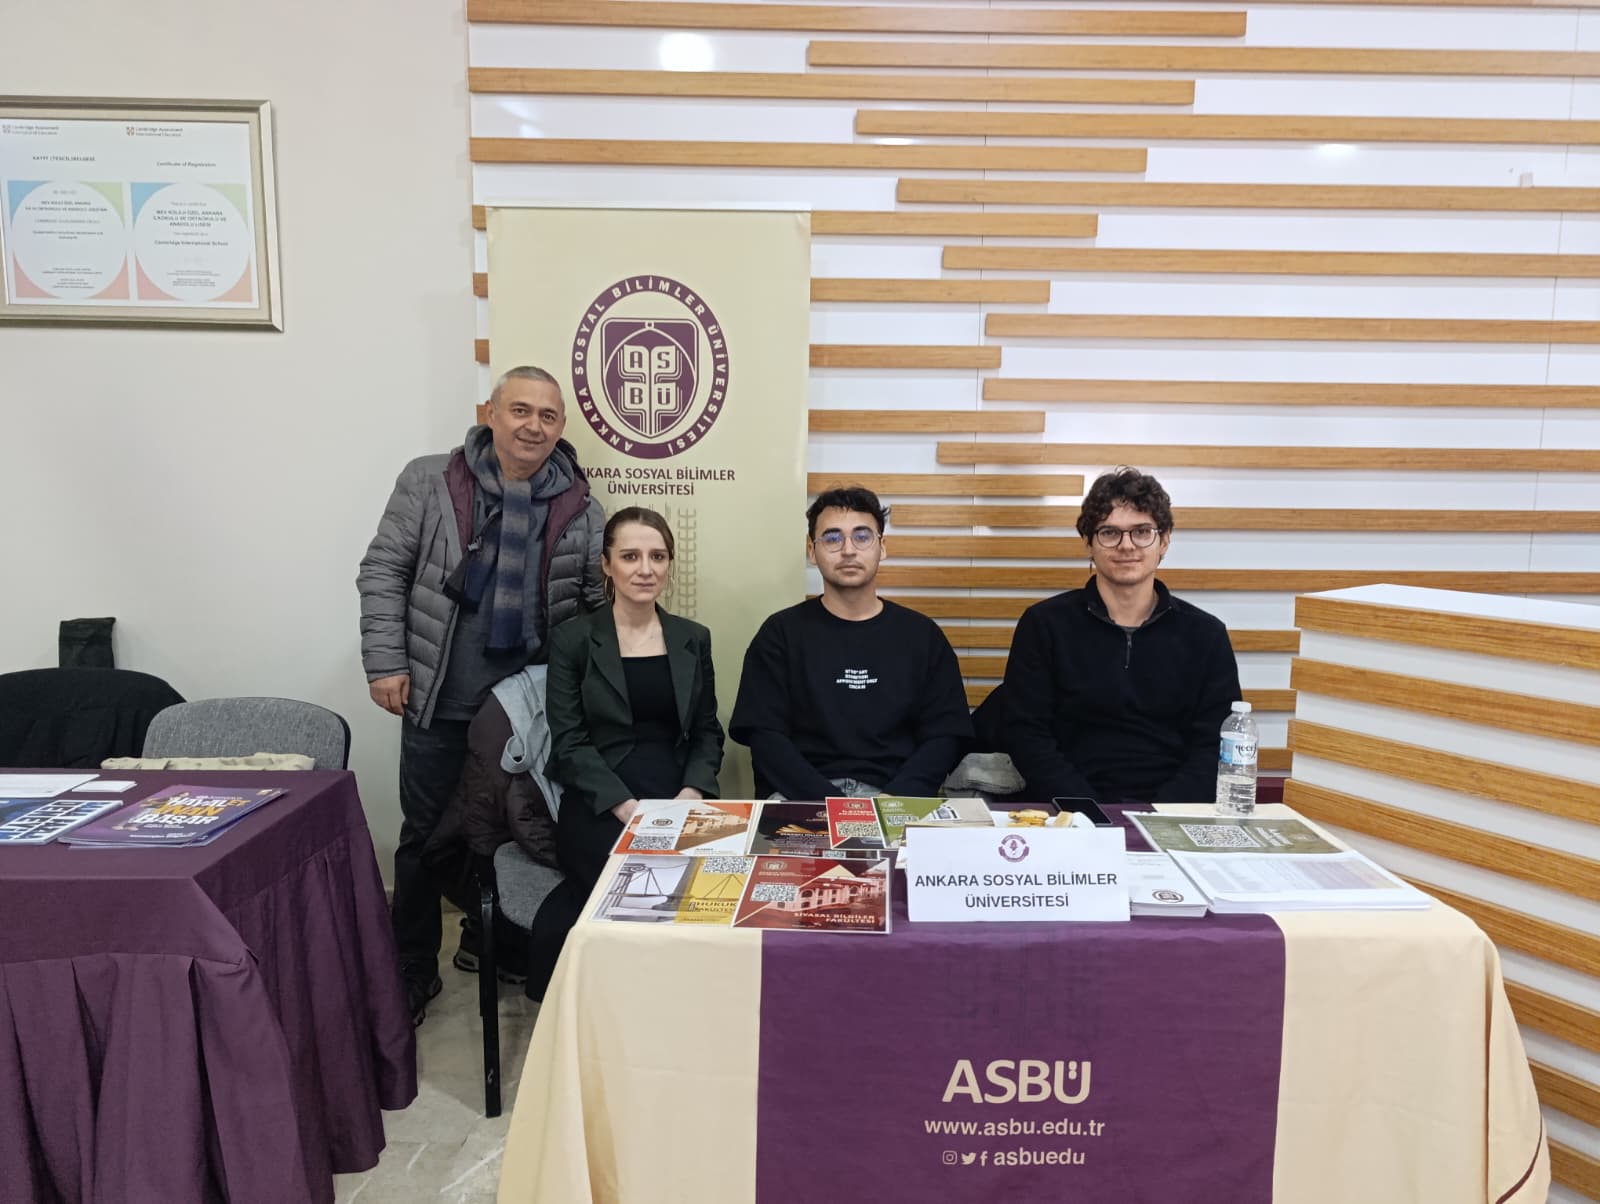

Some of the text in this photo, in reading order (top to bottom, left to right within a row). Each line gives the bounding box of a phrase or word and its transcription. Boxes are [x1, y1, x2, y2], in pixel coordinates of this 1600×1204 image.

[581, 466, 736, 481] KARA SOSYAL BİLİMLER
[607, 480, 695, 496] ÜNİVERSİTESİ
[914, 871, 1118, 888] ANKARA SOSYAL BİLİMLER
[965, 892, 1070, 909] ÜNİVERSİTESİ
[941, 1058, 1092, 1105] ASBÜ
[923, 1117, 1106, 1137] www.asbu.edu.tr
[993, 1146, 1086, 1166] asbuedu
